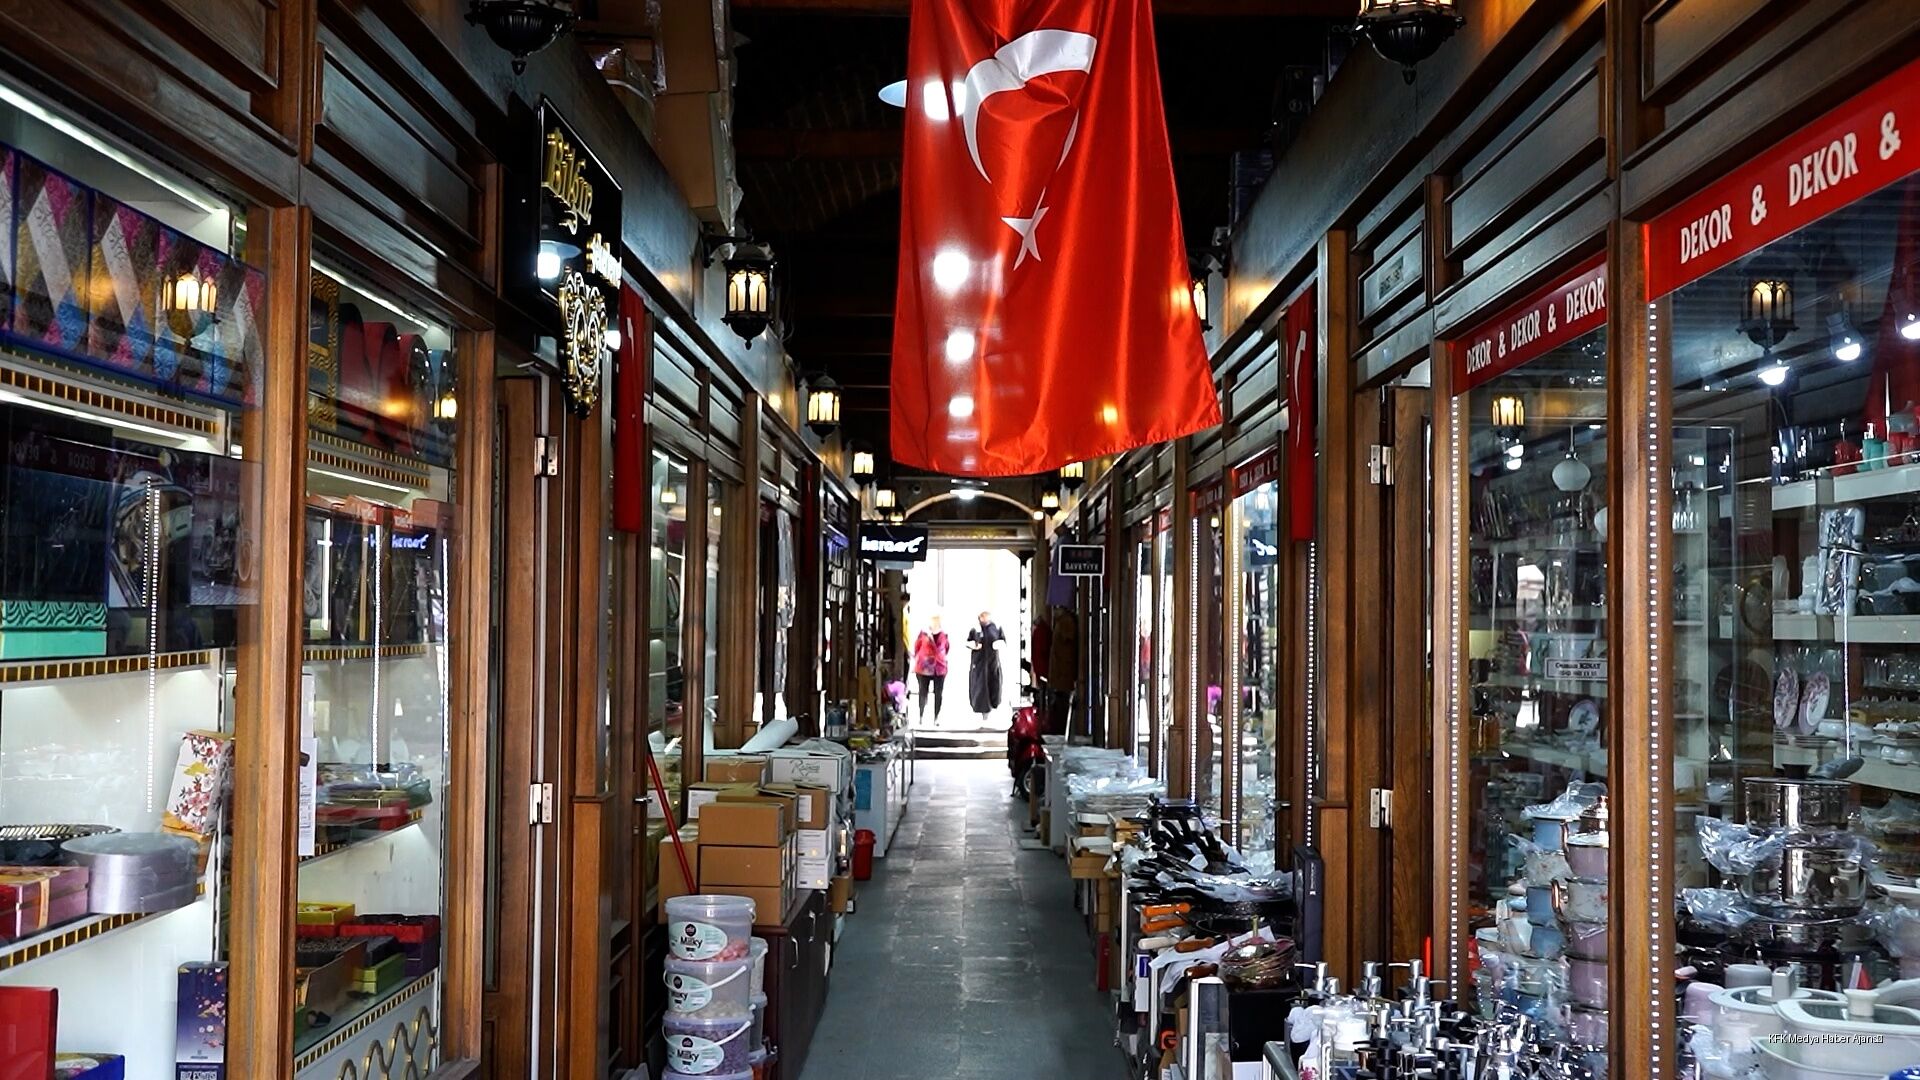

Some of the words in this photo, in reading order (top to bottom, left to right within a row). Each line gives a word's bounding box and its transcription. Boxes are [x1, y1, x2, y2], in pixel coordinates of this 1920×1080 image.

[1681, 203, 1733, 264] DEKOR
[1750, 184, 1768, 225] &
[1789, 132, 1859, 207] DEKOR
[1879, 111, 1902, 160] &
[1466, 339, 1492, 375] DEKOR
[1498, 331, 1506, 358] &
[1511, 309, 1541, 351] DEKOR
[1547, 303, 1557, 333] &
[1566, 277, 1606, 324] DEKOR
